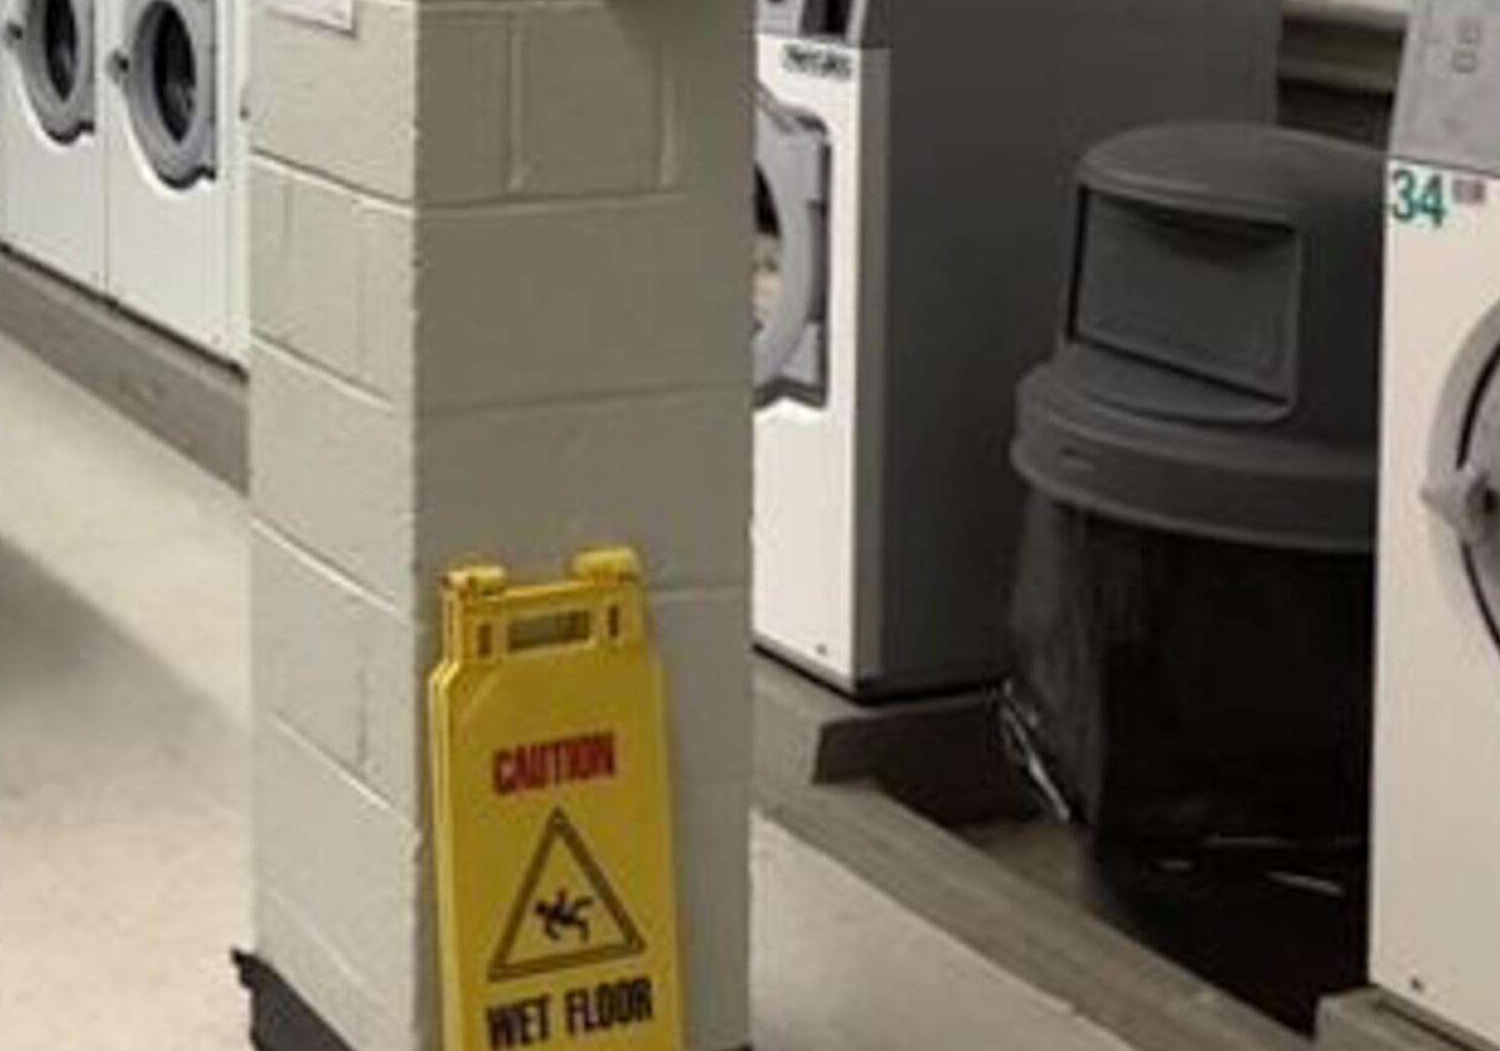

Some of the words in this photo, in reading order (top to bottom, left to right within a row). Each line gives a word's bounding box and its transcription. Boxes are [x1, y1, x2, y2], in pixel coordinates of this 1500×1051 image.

[1391, 166, 1445, 228] 34
[493, 731, 616, 796] CAUTION
[486, 993, 550, 1050] WET
[565, 977, 654, 1037] FLOOR
